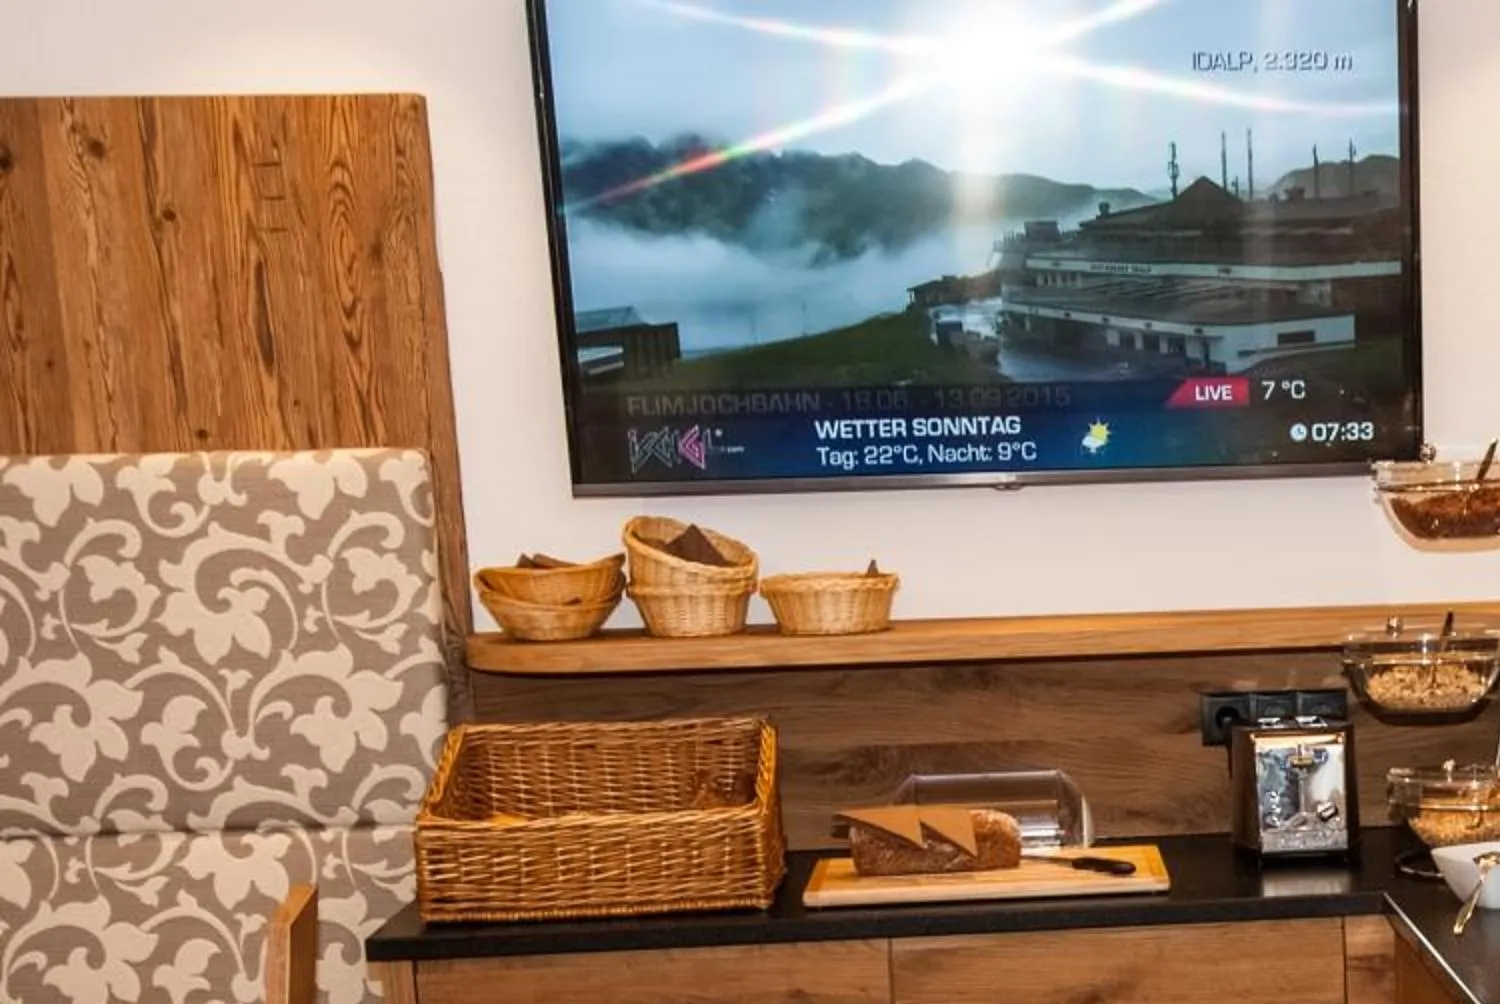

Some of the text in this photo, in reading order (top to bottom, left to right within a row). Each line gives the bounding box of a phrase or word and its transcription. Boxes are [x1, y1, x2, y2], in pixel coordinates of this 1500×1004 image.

[1192, 51, 1353, 72] IDALP, 2.320 m
[1194, 384, 1232, 401] LIVE
[1261, 379, 1306, 400] 7 °C
[627, 391, 821, 417] FLIMJOCHBAHN
[814, 415, 1022, 440] WETTER SONNTAG
[1311, 421, 1374, 441] 07:33
[816, 440, 1037, 470] Tag: 22°C, Nacht: 9°C
